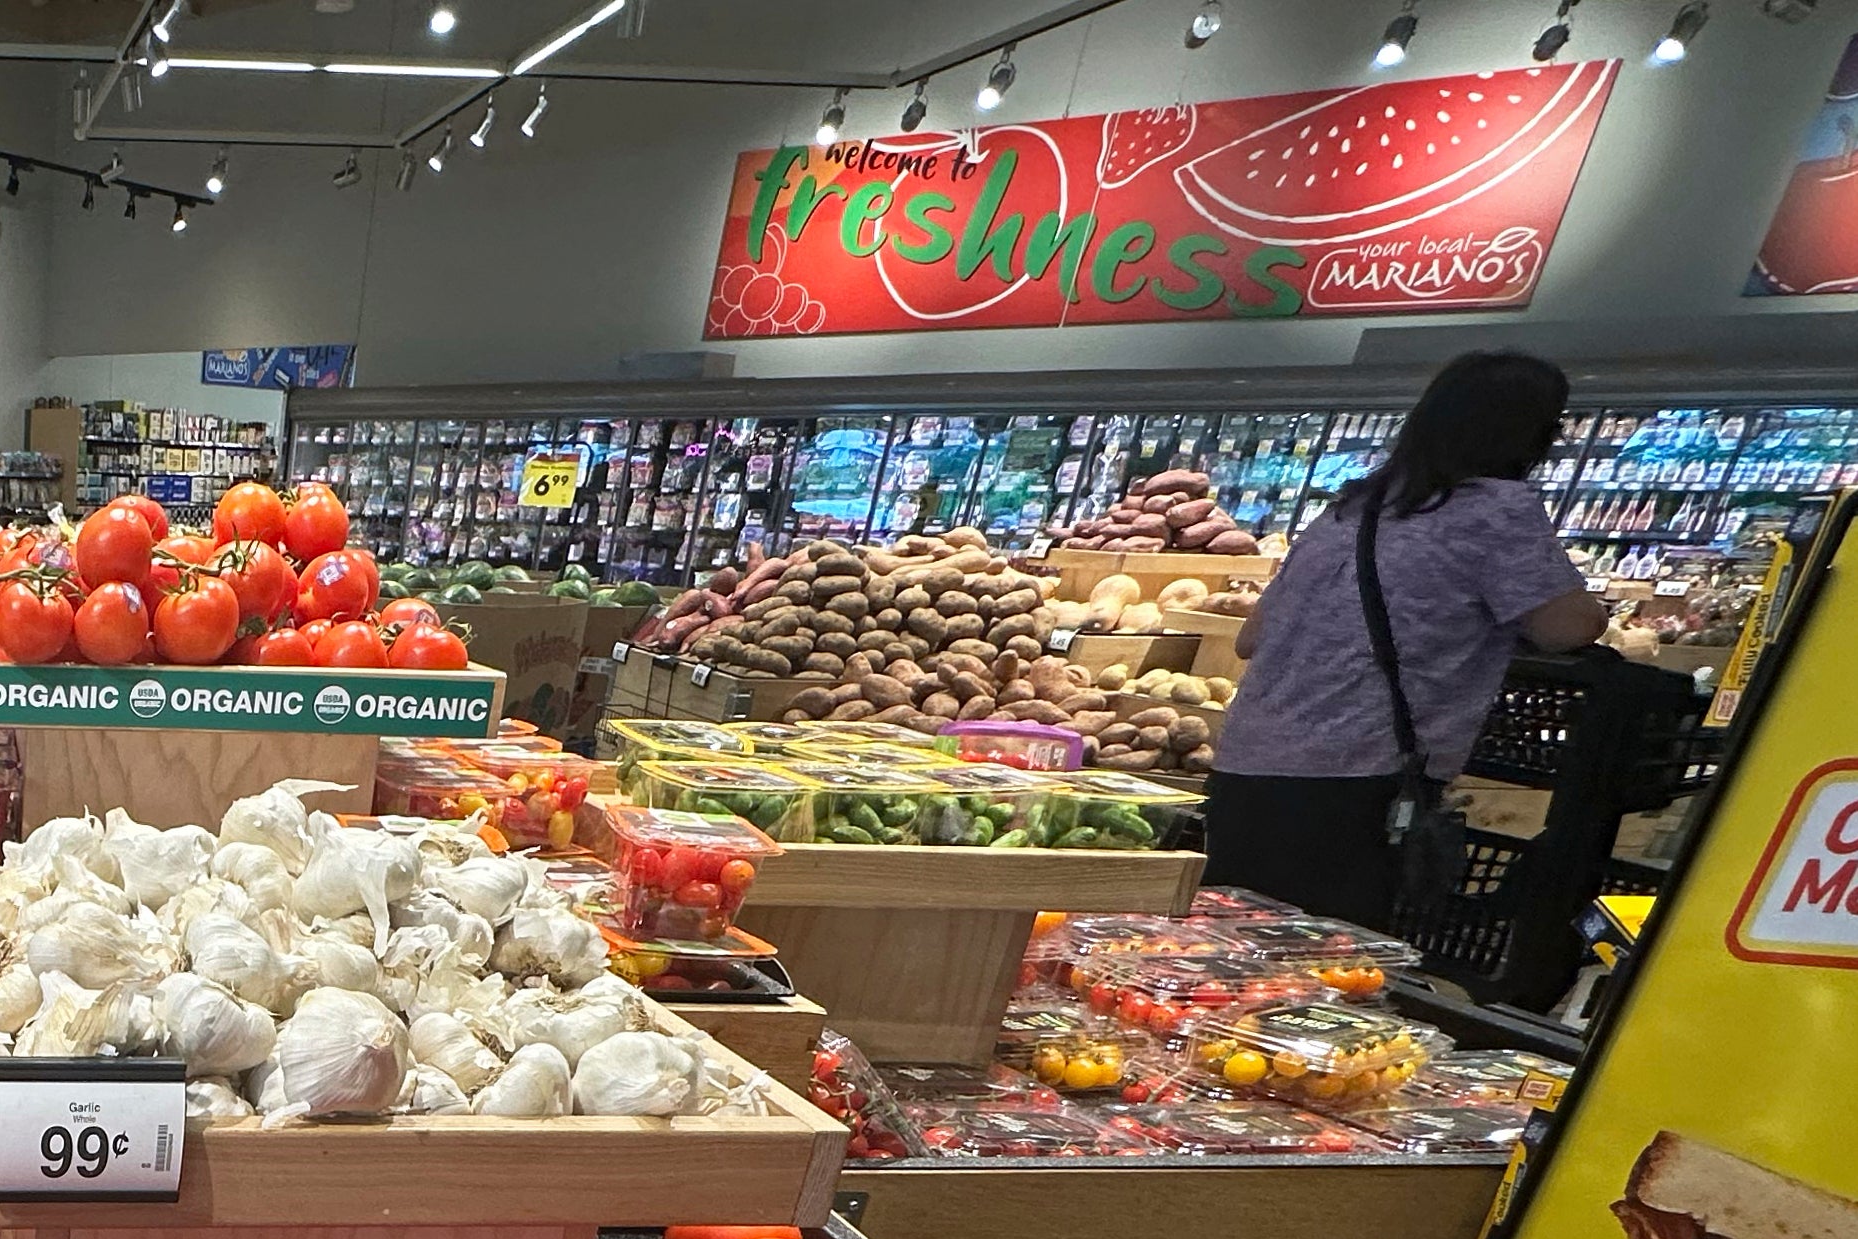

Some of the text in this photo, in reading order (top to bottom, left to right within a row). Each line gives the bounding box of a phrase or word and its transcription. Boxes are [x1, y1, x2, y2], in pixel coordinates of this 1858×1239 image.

[824, 141, 979, 182] welcome to
[745, 144, 1308, 318] freshness
[1358, 232, 1473, 263] your local
[1320, 250, 1529, 298] MARIANO'S
[1747, 593, 1772, 645] Cooked
[137, 688, 159, 698] USDA
[169, 687, 305, 716] ORGANIC
[354, 694, 488, 723] ORGANIC
[69, 1102, 101, 1114] Garlic
[73, 1115, 97, 1124] Whole
[40, 1125, 130, 1179] 99¢
